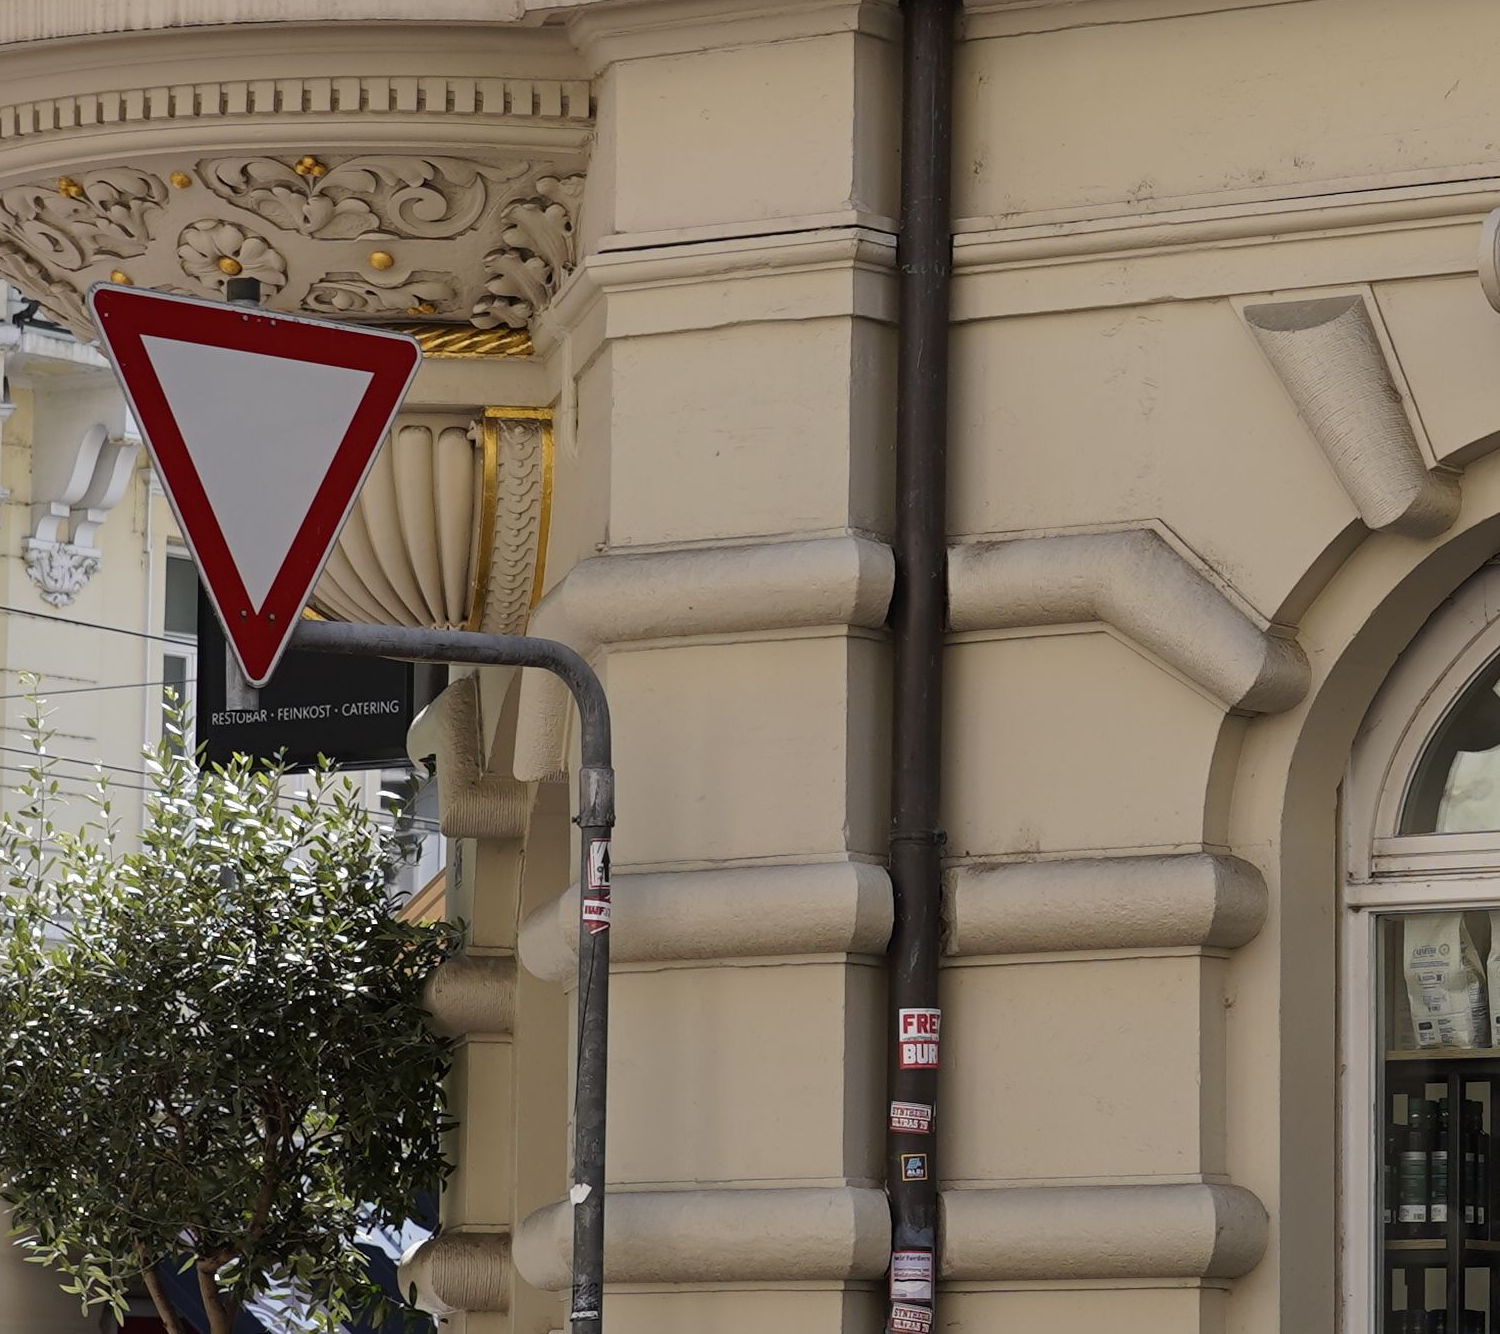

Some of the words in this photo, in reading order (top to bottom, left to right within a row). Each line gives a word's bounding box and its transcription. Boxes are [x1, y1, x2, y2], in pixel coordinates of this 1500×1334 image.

[212, 709, 267, 725] RESTOBAR
[277, 704, 332, 721] FEINKOST
[341, 700, 400, 716] CATERING
[902, 1013, 940, 1034] FRE
